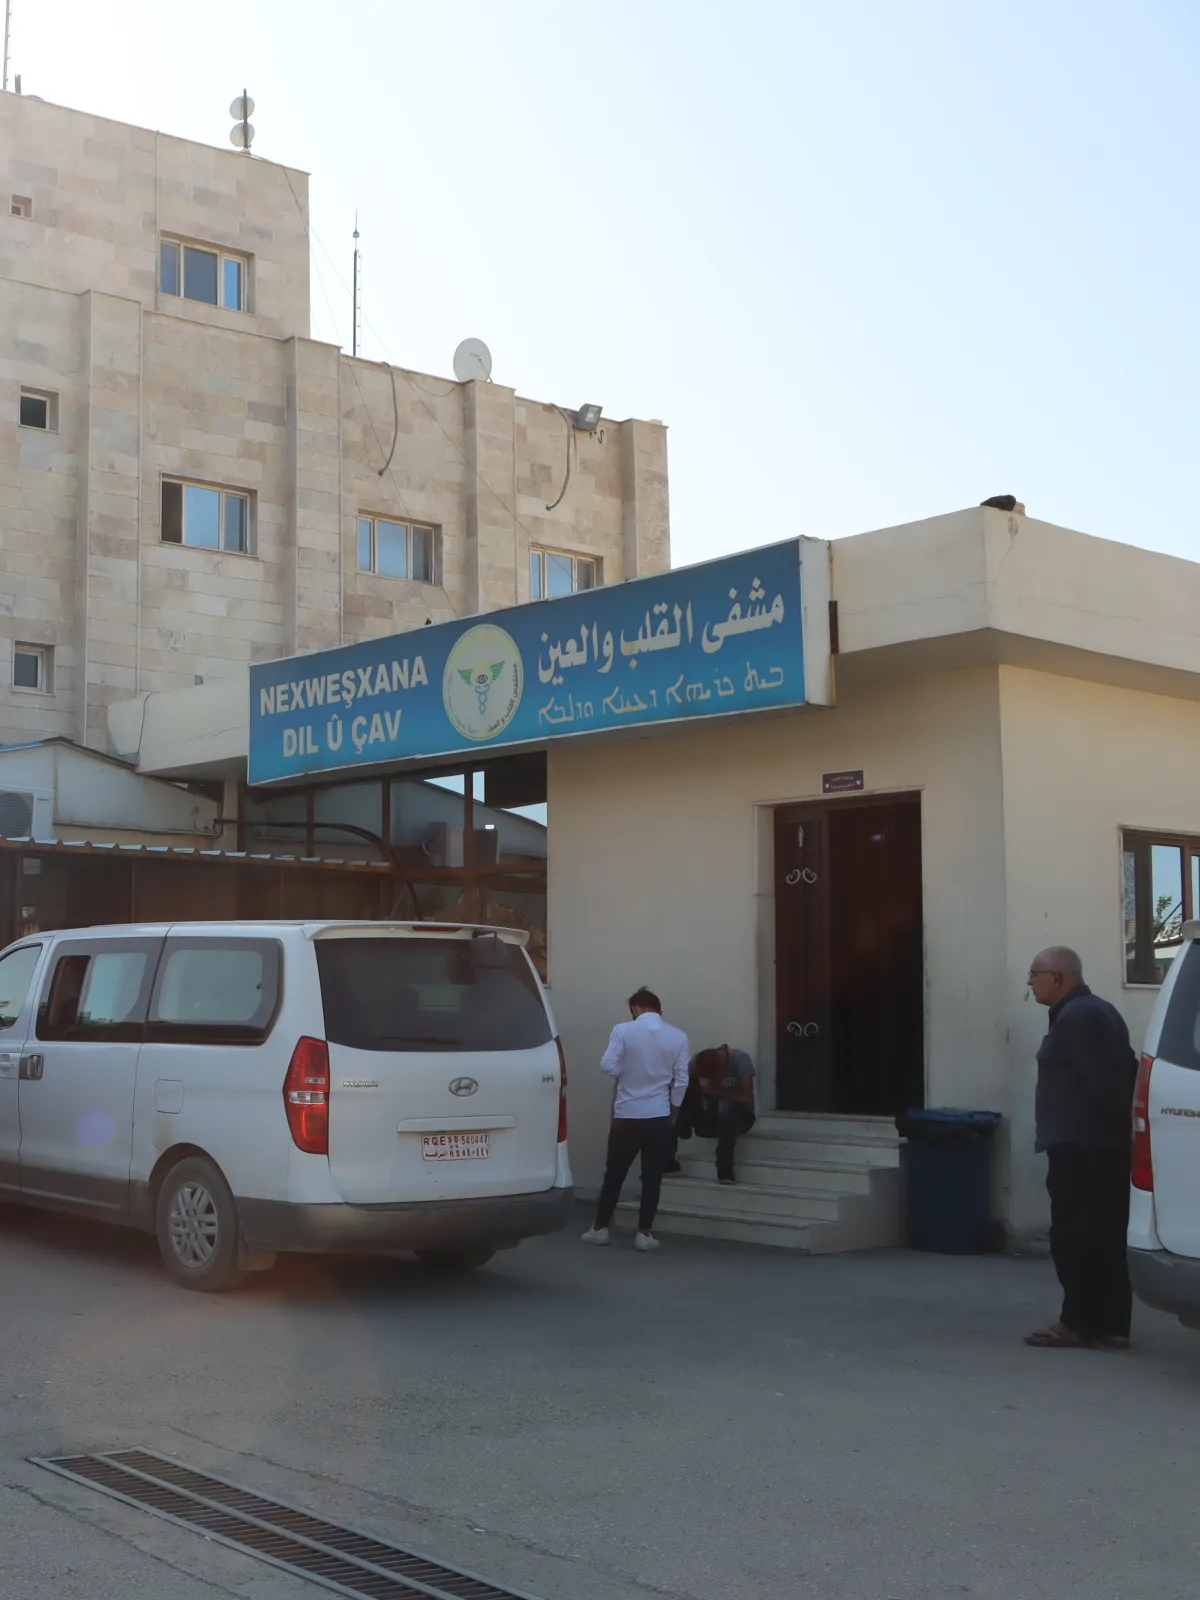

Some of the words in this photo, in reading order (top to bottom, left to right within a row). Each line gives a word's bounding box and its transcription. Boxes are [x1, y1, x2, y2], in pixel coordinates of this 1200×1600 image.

[620, 601, 694, 670] القلب
[702, 577, 785, 654] مشفى
[538, 621, 614, 685] والعين
[260, 656, 429, 716] NEXWEŞXANA
[282, 727, 319, 757] DIL
[326, 714, 343, 751] Û
[351, 709, 403, 755] ÇAV
[423, 1136, 446, 1146] RQE
